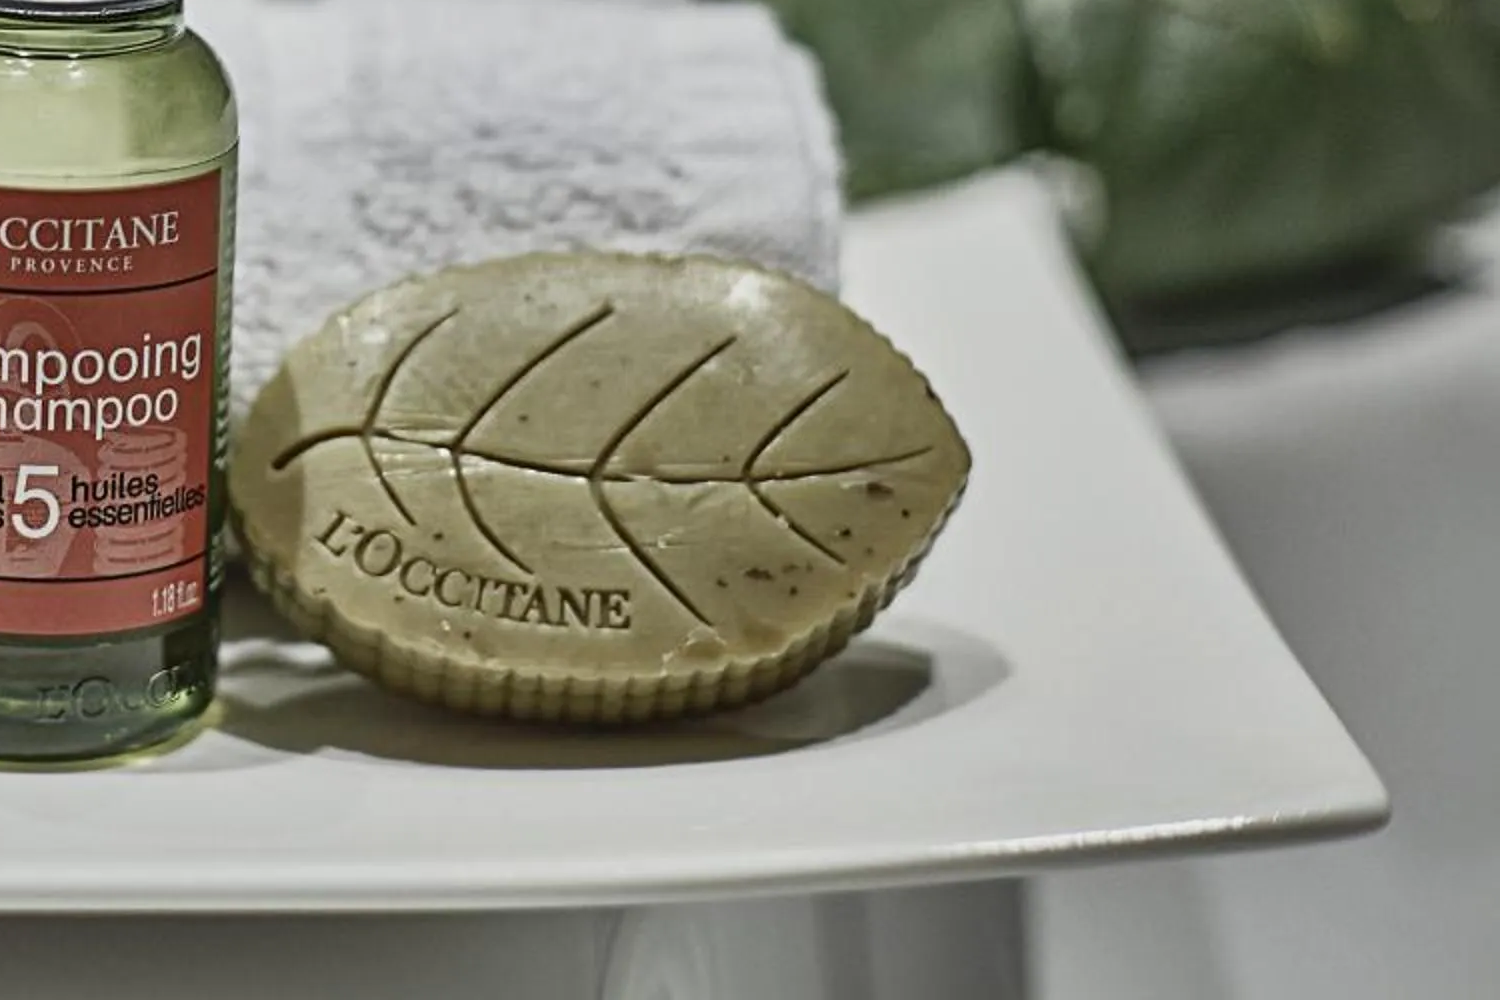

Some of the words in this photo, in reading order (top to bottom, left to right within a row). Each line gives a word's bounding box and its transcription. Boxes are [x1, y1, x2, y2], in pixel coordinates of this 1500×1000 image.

[11, 256, 134, 273] PROVENCE
[10, 464, 60, 539] 5
[67, 484, 205, 529] essentielles
[70, 472, 159, 502] huiles
[314, 510, 633, 631] L'OCCITANE
[152, 582, 176, 618] 1.18
